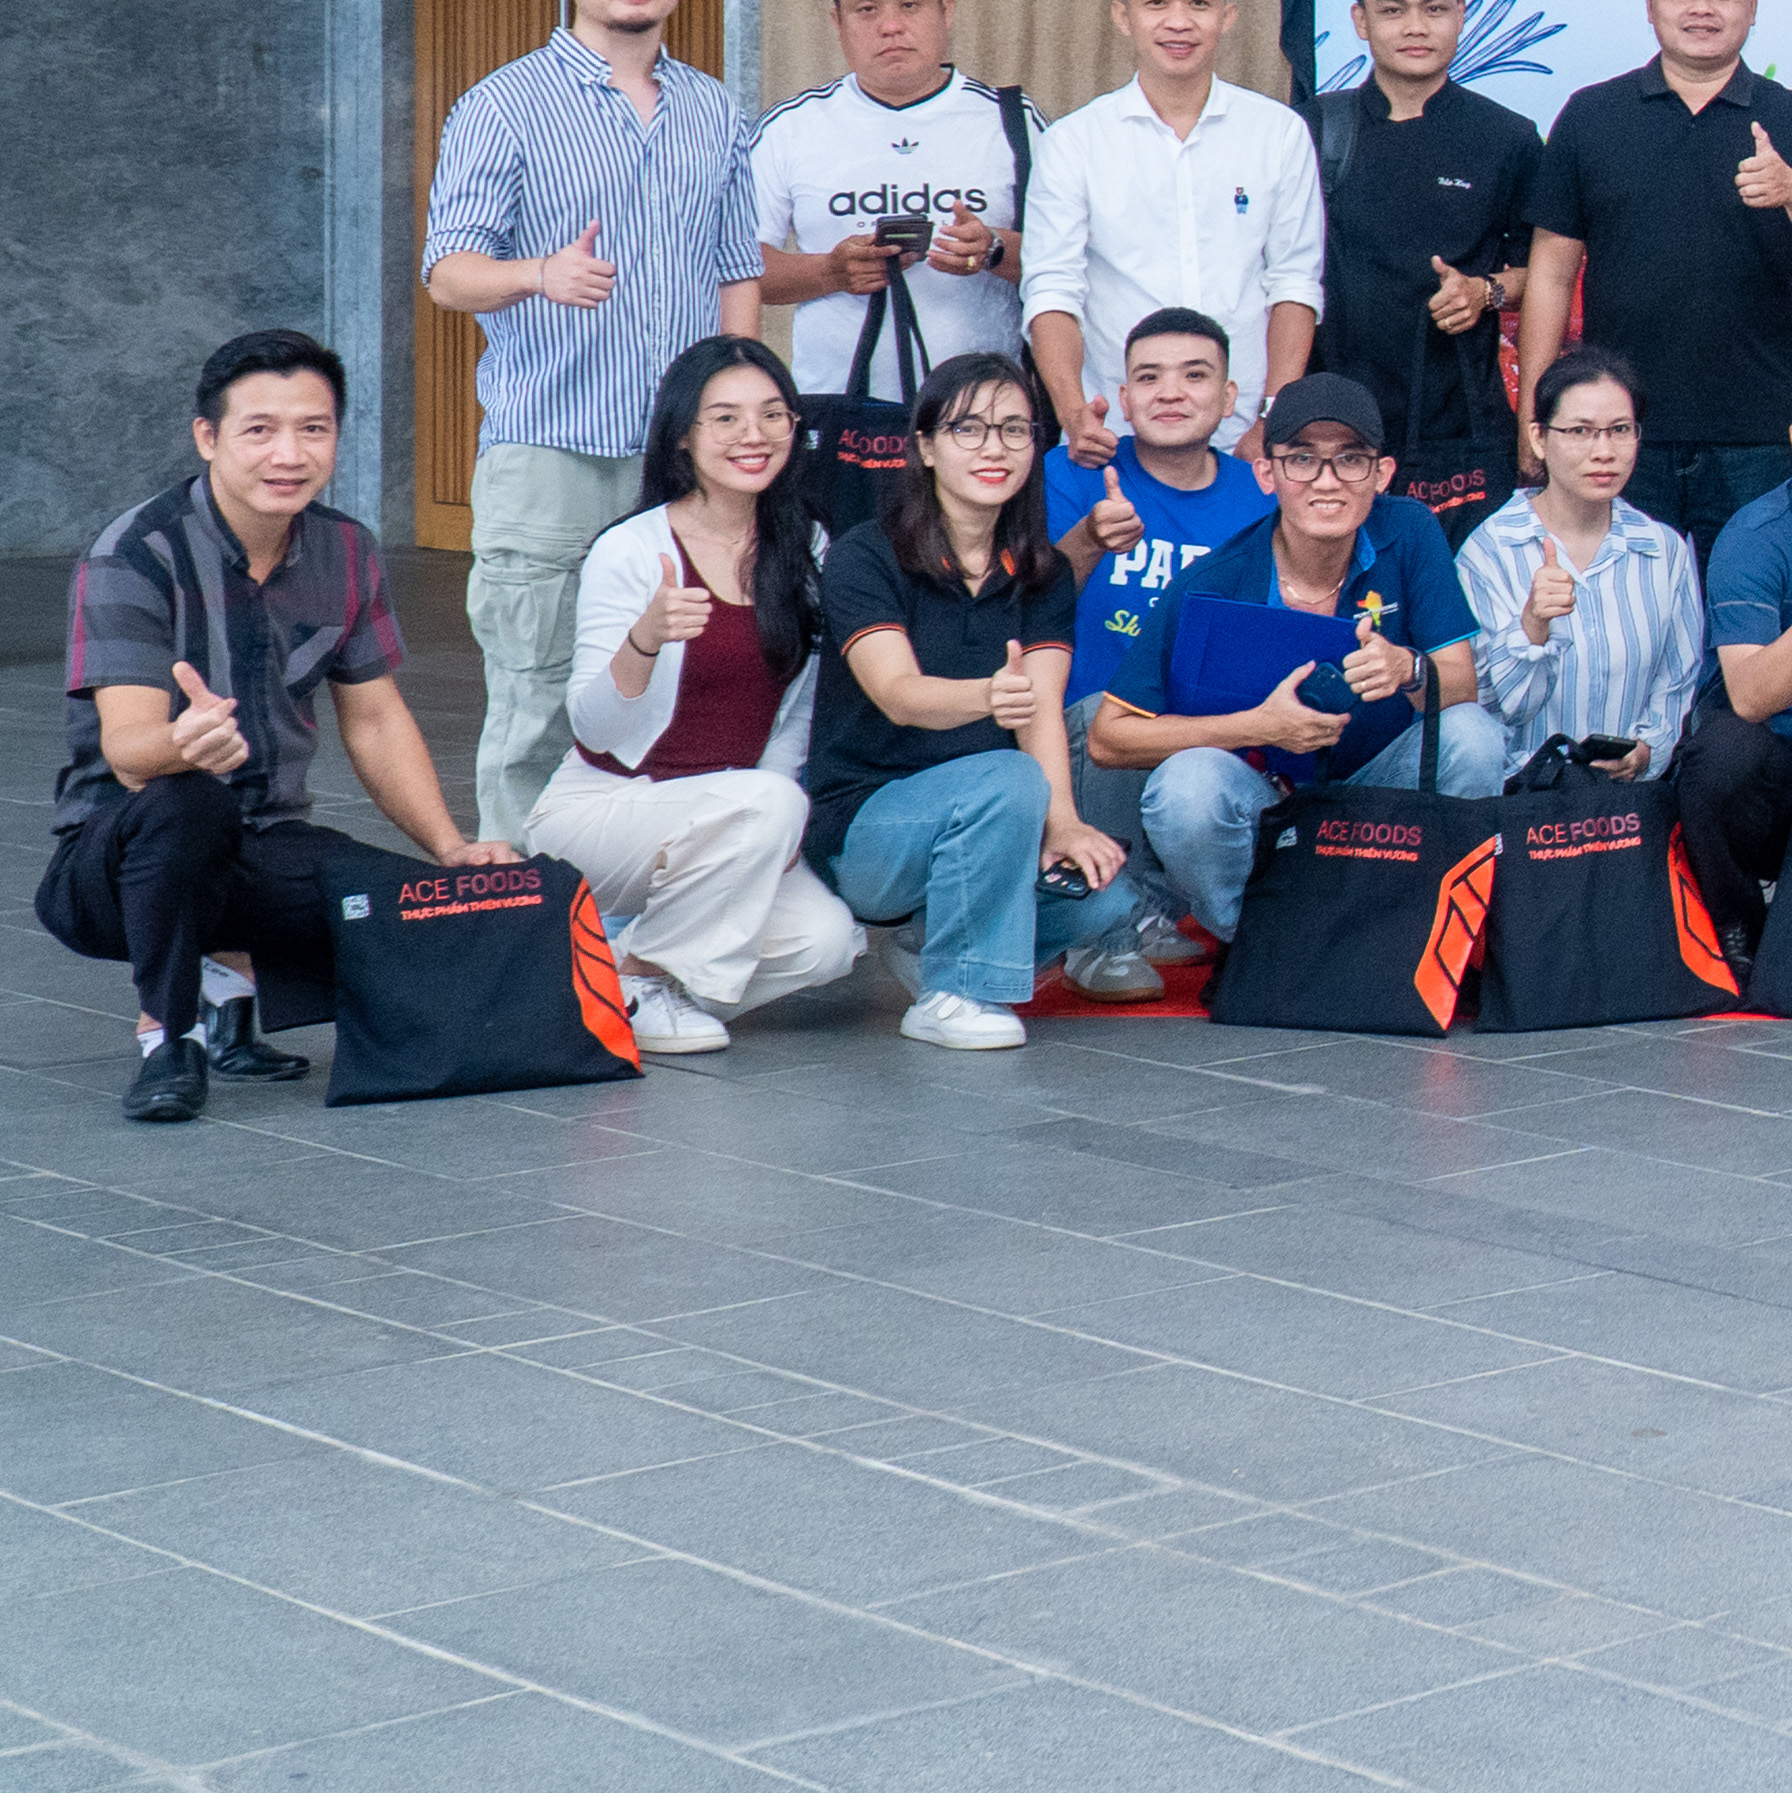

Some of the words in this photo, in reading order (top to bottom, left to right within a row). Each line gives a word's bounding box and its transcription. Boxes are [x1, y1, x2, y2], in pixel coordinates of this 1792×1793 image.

[828, 183, 988, 216] adidas
[1316, 819, 1349, 841] ACE
[1351, 821, 1422, 847] FOODS
[1526, 823, 1568, 845] ACE
[1569, 812, 1641, 841] FOODS
[398, 878, 451, 905] ACE
[456, 868, 542, 897] FOODS
